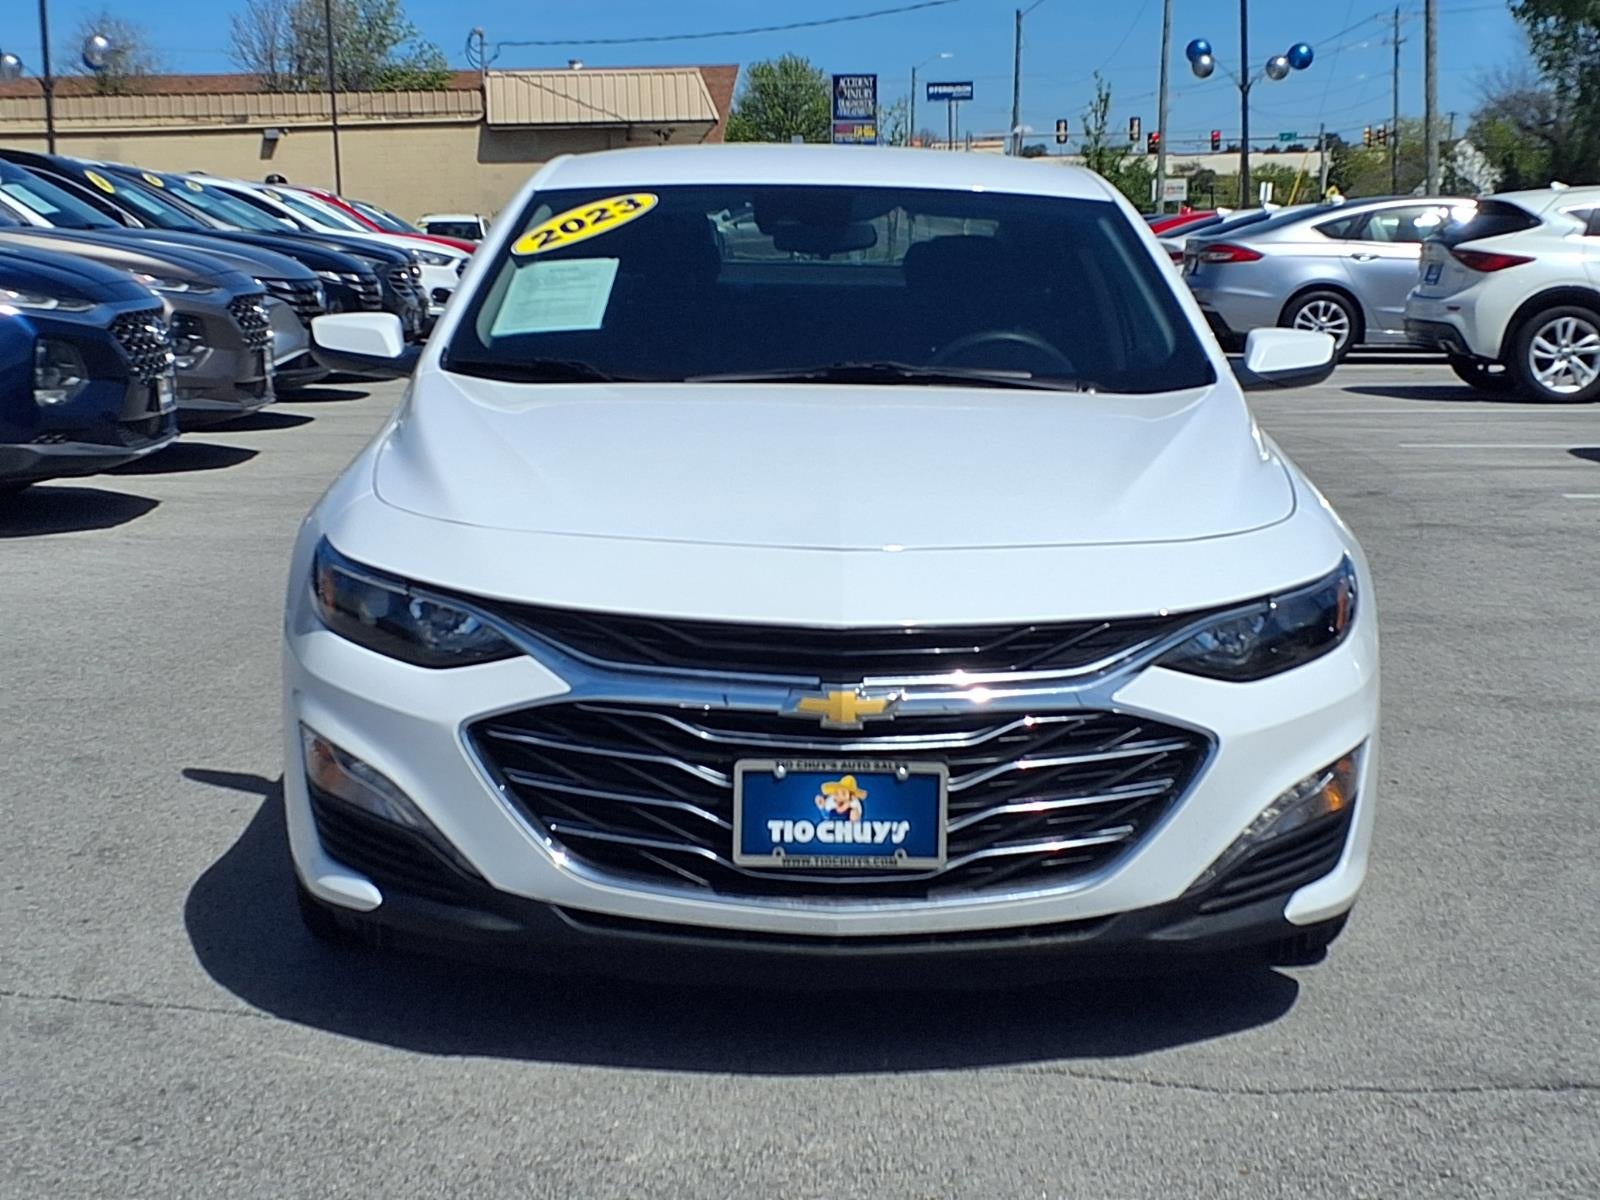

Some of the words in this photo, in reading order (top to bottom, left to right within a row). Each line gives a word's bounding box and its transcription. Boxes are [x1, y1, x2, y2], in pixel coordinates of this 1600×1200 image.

[531, 198, 642, 249] 2023
[840, 761, 871, 770] AUTO
[767, 820, 815, 843] TIO
[816, 820, 910, 844] CHUY'S
